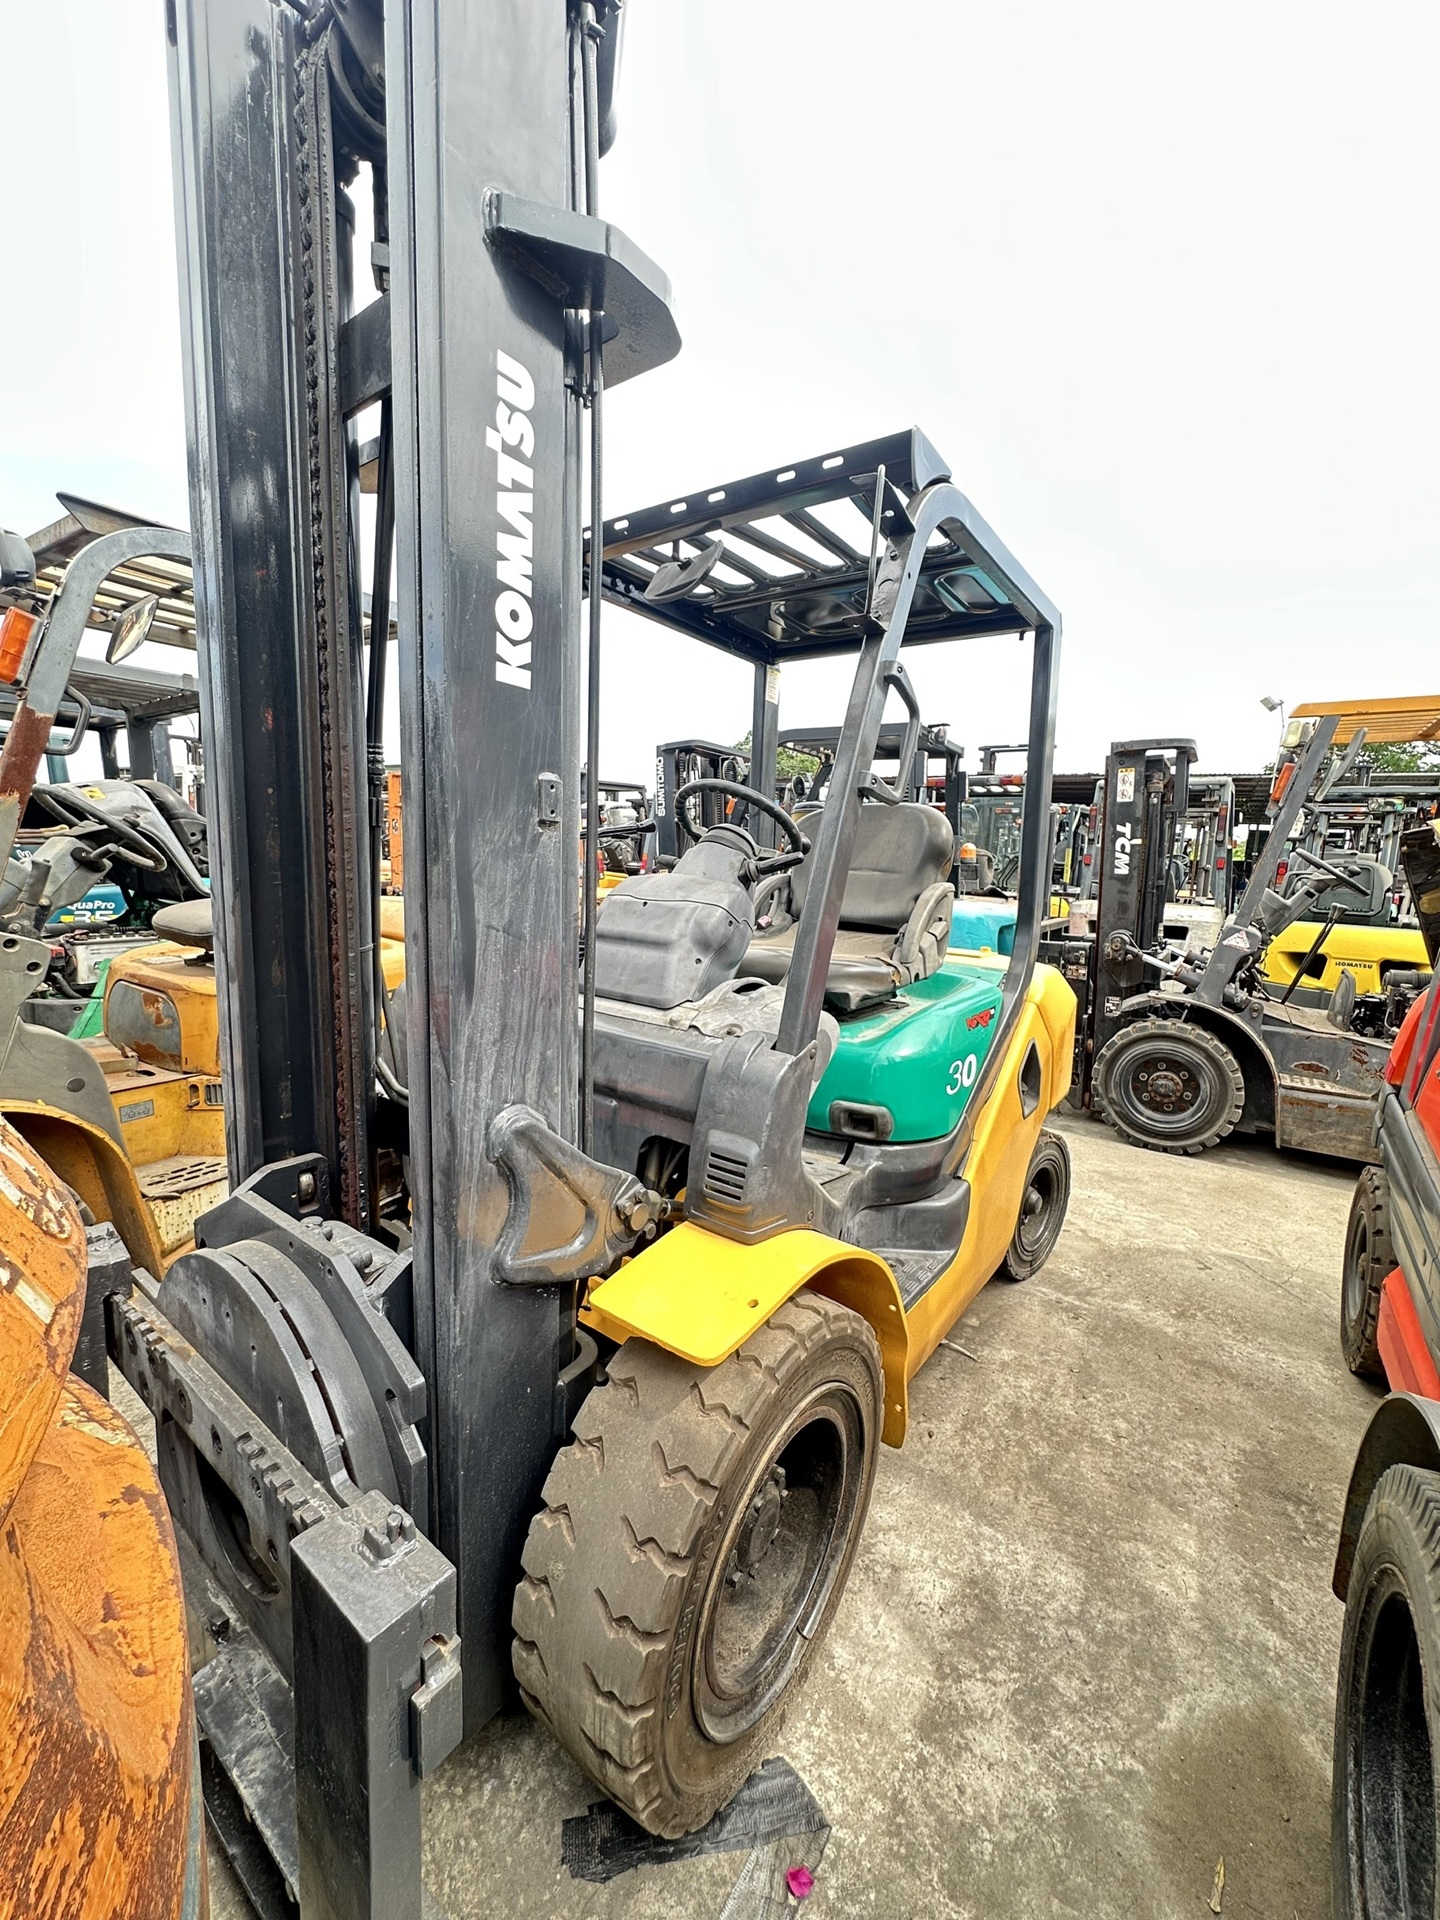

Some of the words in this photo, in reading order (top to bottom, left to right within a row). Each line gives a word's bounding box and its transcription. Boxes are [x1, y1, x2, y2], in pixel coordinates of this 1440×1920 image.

[485, 348, 535, 691] KOMATSU
[657, 756, 666, 817] SUMITOMO
[1114, 822, 1132, 875] TCM
[1335, 961, 1373, 969] KOMATSU
[945, 1053, 977, 1096] 30
